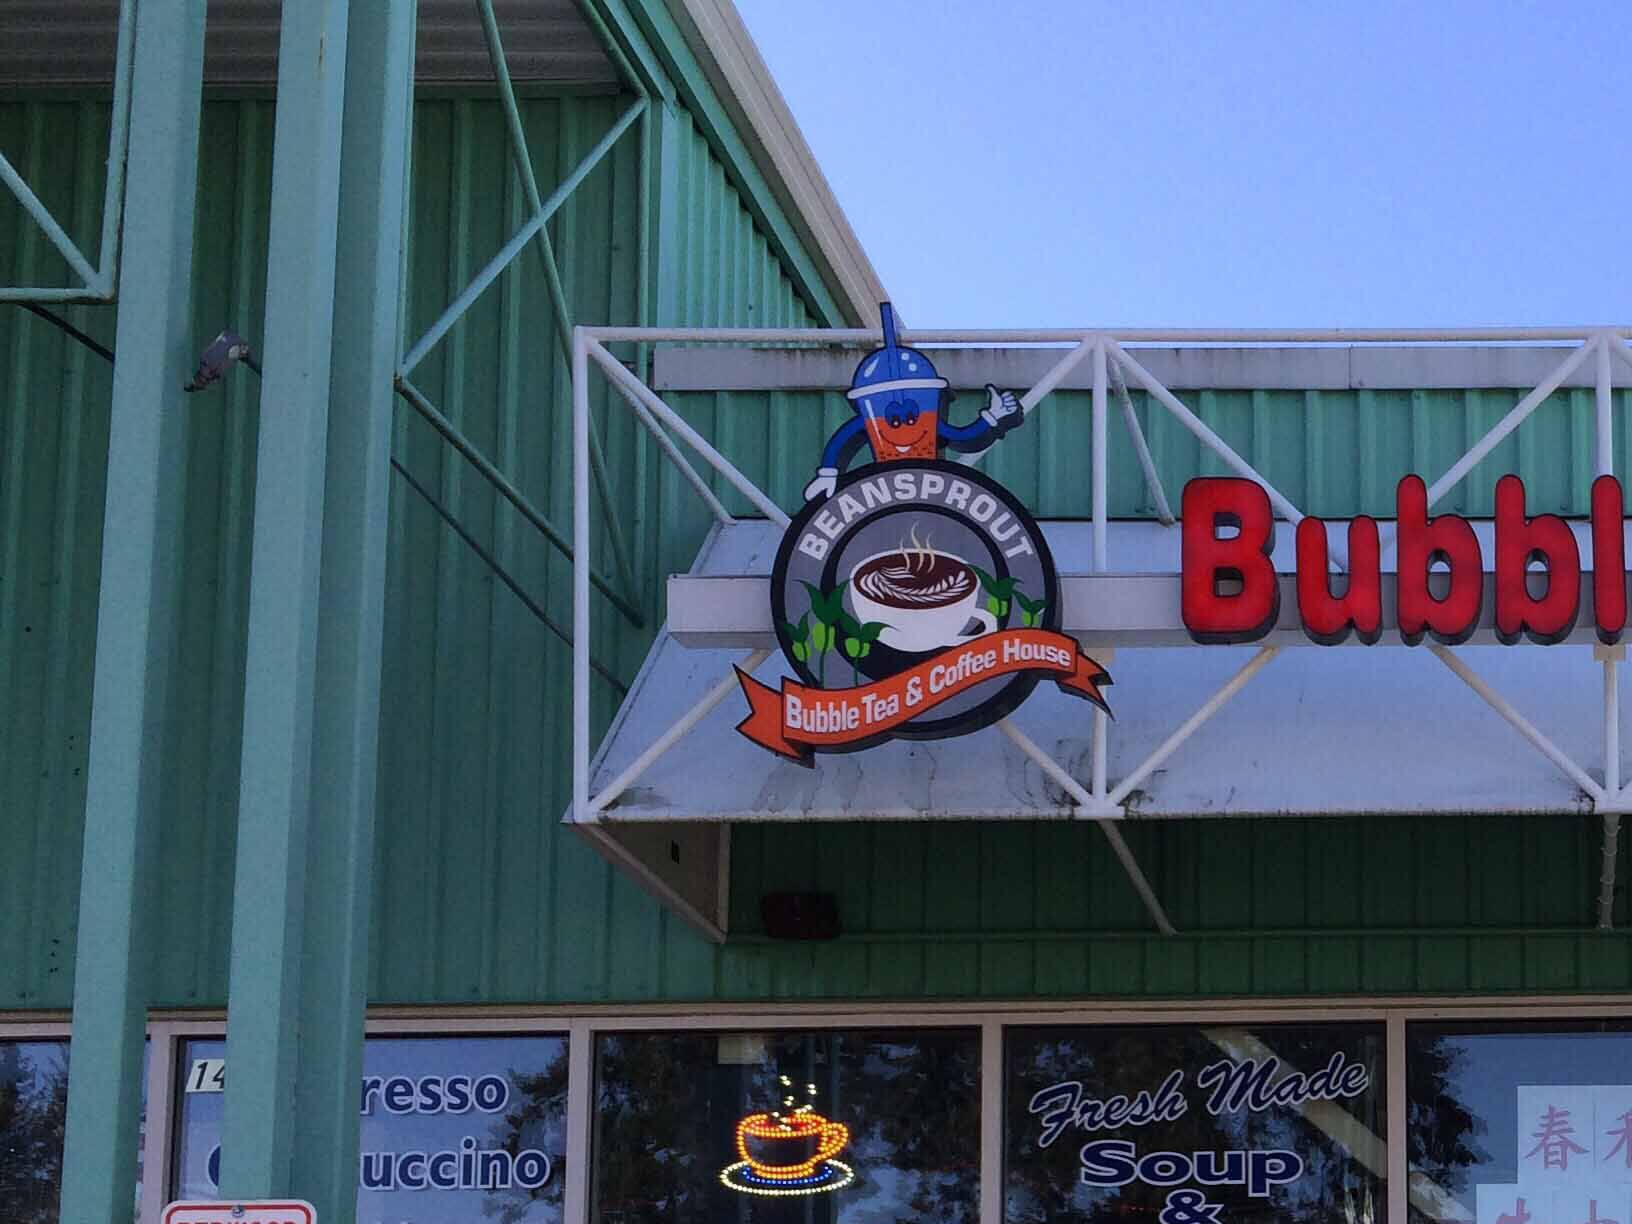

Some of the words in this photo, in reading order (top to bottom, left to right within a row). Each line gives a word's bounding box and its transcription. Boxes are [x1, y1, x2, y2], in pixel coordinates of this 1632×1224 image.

[798, 472, 1034, 562] BEANSPROUT
[785, 694, 860, 734] Bubble
[861, 691, 900, 725] Tea
[904, 676, 924, 706] &
[928, 647, 997, 693] Coffee
[1002, 638, 1072, 668] House
[361, 1073, 510, 1116] resso
[1029, 1069, 1188, 1148] Fresh
[1198, 1051, 1370, 1114] Made
[1080, 1140, 1303, 1197] Soup
